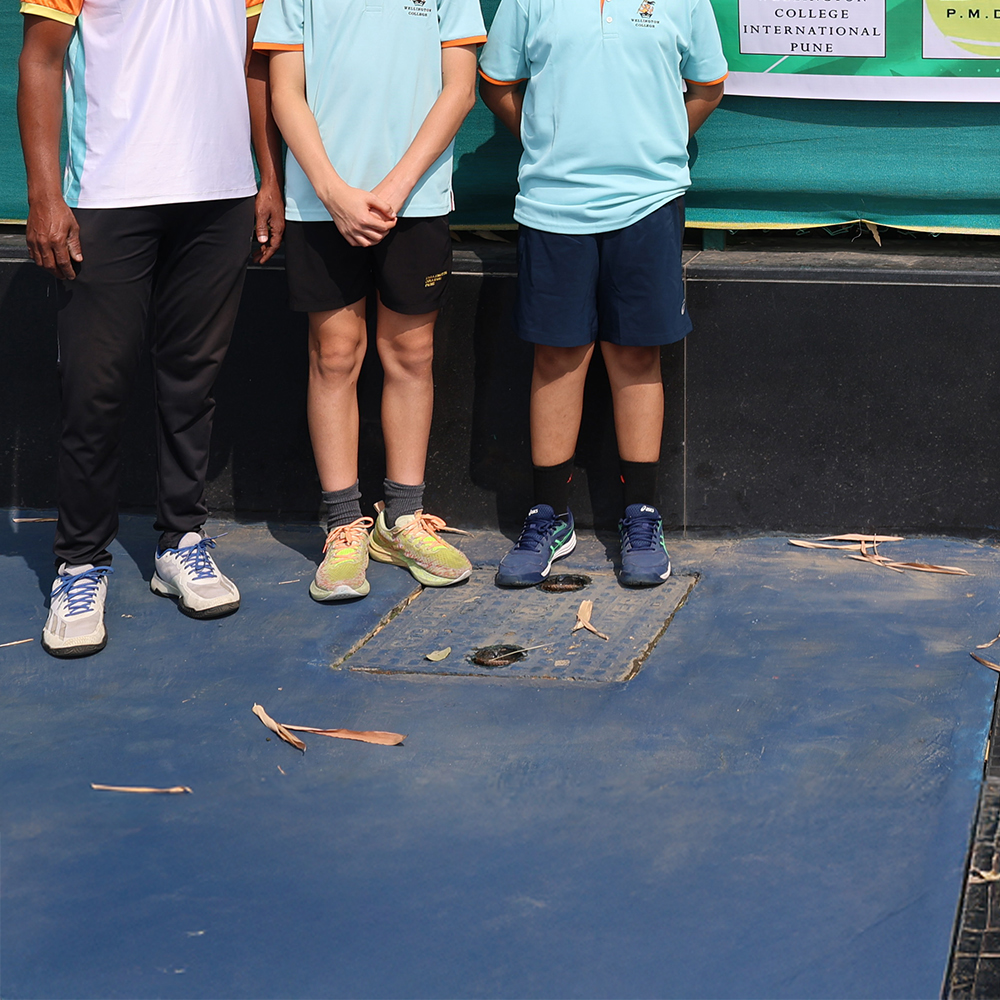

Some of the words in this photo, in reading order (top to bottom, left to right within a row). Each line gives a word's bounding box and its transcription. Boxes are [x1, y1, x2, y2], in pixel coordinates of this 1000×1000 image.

[774, 8, 849, 19] COLLEGE
[743, 24, 881, 37] INTERNATIONAL
[790, 42, 834, 53] PUNE
